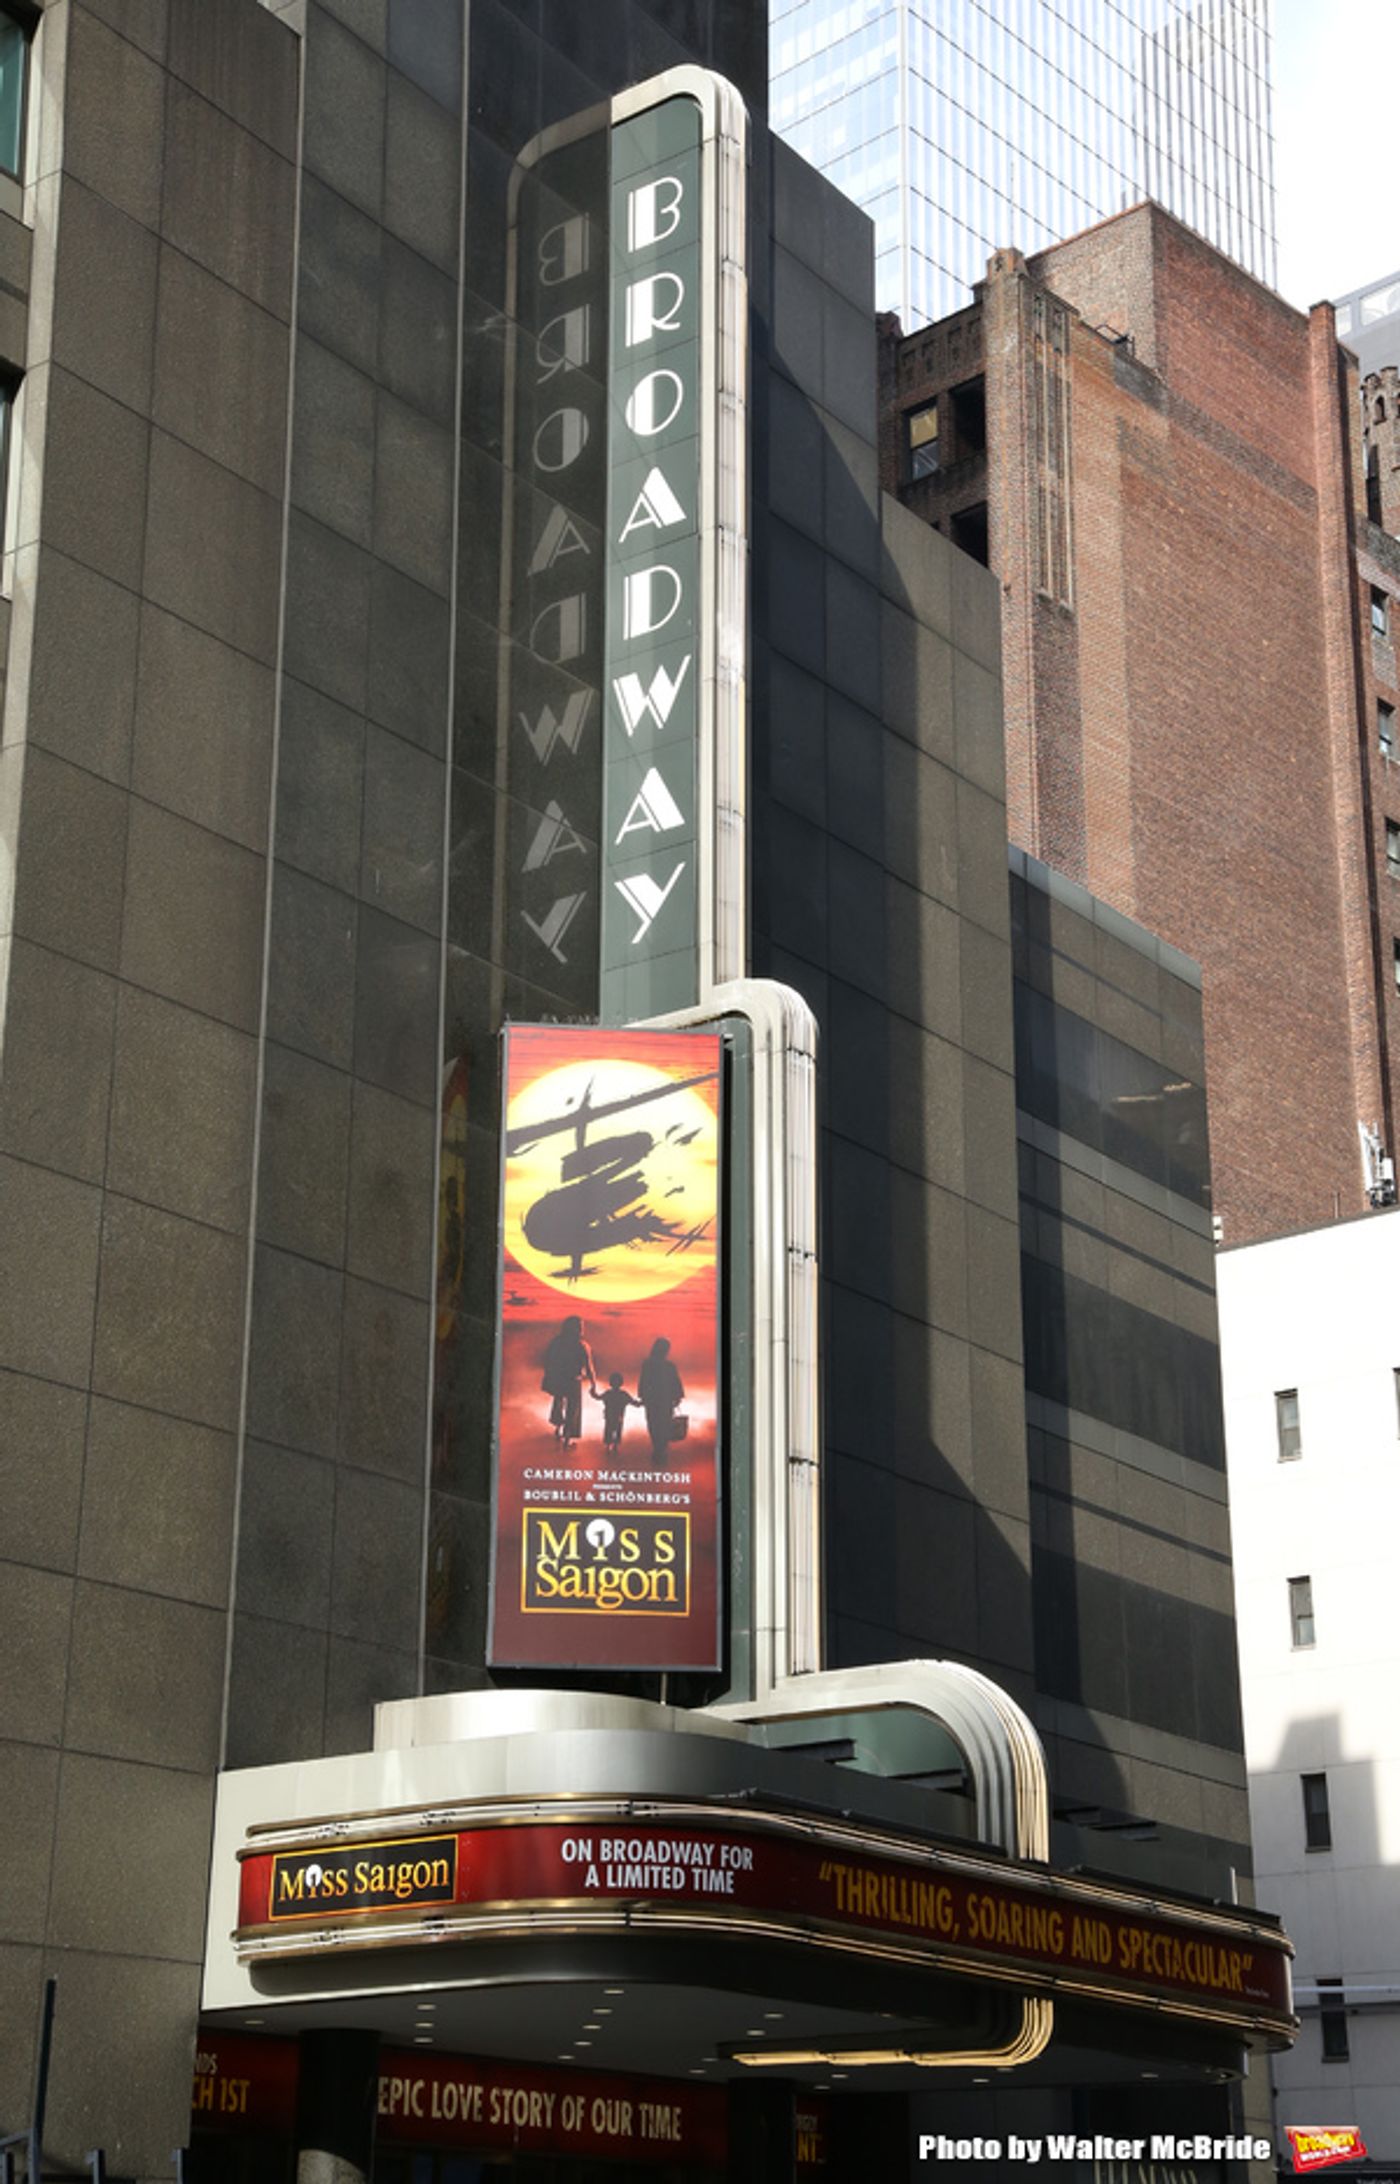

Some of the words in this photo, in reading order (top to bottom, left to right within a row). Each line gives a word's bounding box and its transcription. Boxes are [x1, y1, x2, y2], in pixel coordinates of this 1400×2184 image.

[613, 174, 692, 946] BROADWAY
[523, 1468, 594, 1481] CAMERON
[597, 1470, 691, 1484] MACKINTOSH
[523, 1489, 582, 1502] BOUBLIL
[585, 1491, 596, 1502] &
[536, 1518, 676, 1564] Miss
[535, 1557, 678, 1609] Saigon
[561, 1839, 593, 1862] ON
[599, 1839, 714, 1866] BROADWAY
[720, 1845, 754, 1871] FOR
[279, 1863, 349, 1901] Miss
[353, 1856, 450, 1895] Saigon
[585, 1866, 600, 1888] A
[606, 1864, 686, 1890] LIMITED
[692, 1868, 735, 1894] TIME
[967, 1892, 1065, 1955] SOARING
[1071, 1914, 1113, 1966] AND
[377, 2076, 425, 2118] EPIC
[431, 2080, 484, 2123] LOVE
[489, 2086, 556, 2130] STORY
[561, 2094, 586, 2133] OF
[590, 2096, 633, 2137] OUR
[638, 2101, 683, 2142] TIME
